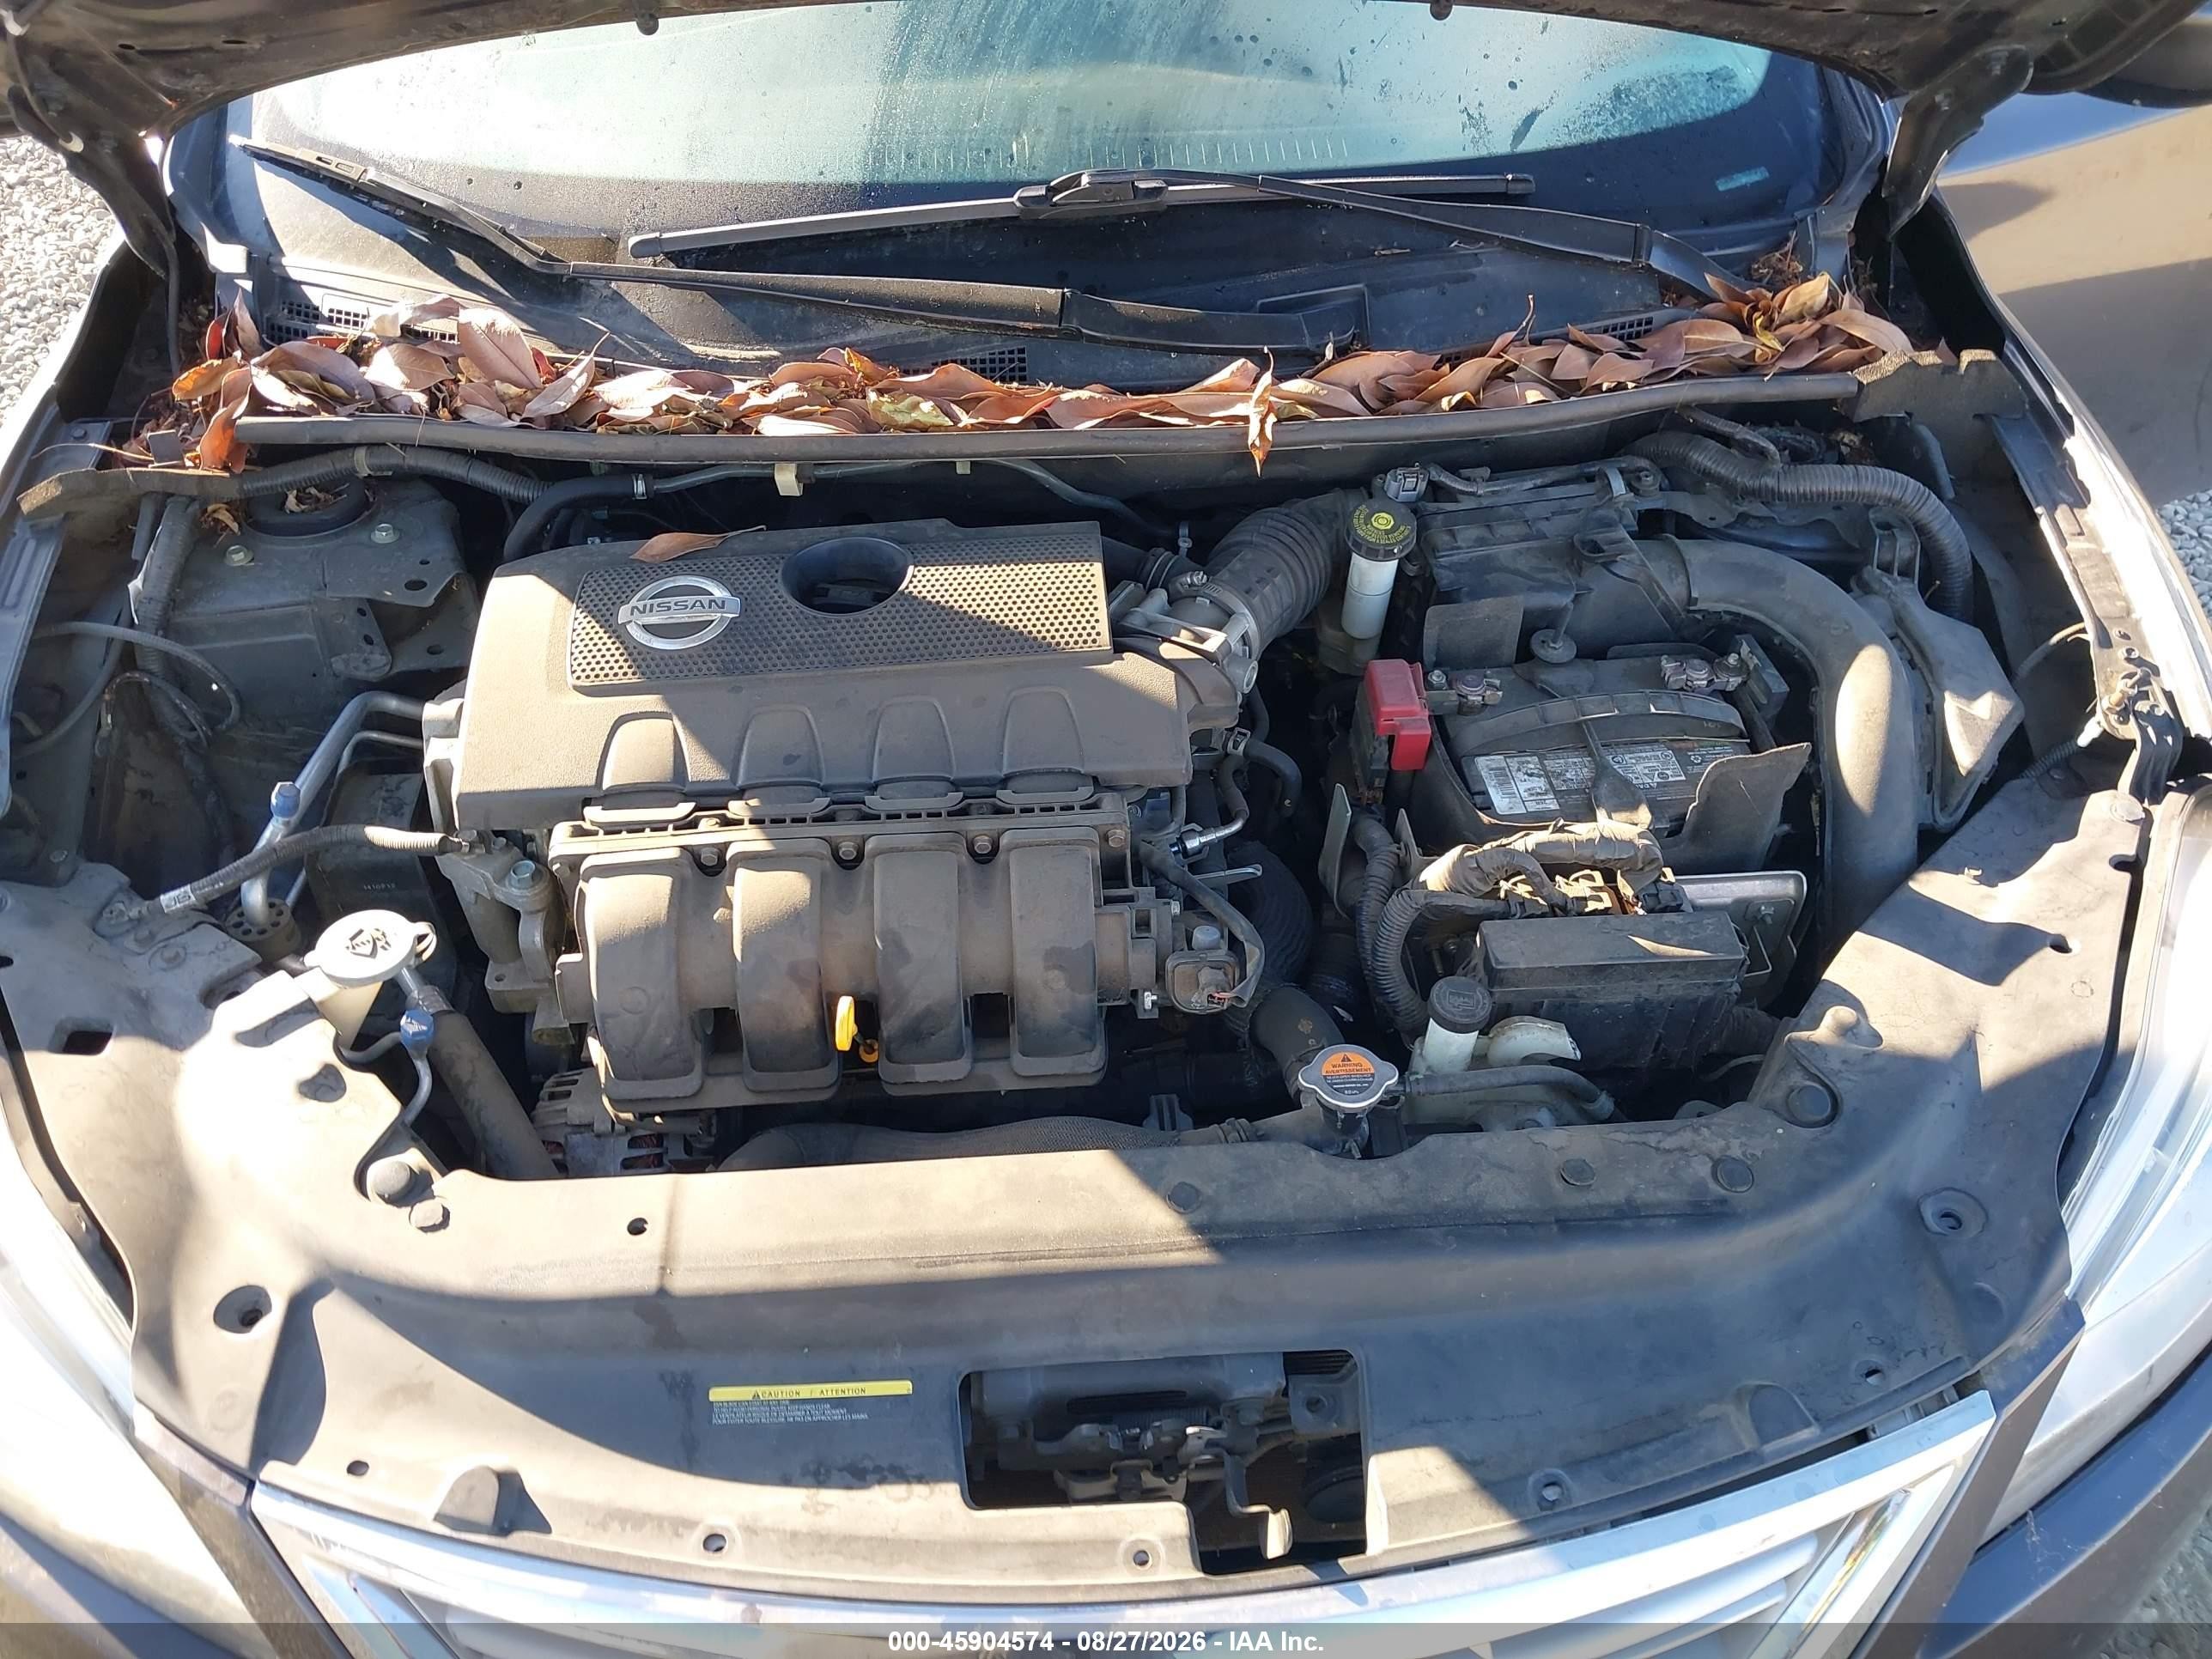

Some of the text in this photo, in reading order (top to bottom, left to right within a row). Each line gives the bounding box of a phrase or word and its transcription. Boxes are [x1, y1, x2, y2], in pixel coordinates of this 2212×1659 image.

[629, 599, 726, 616] NISSAN
[761, 1390, 800, 1399] CAUTION
[818, 1387, 866, 1397] ATTENTION
